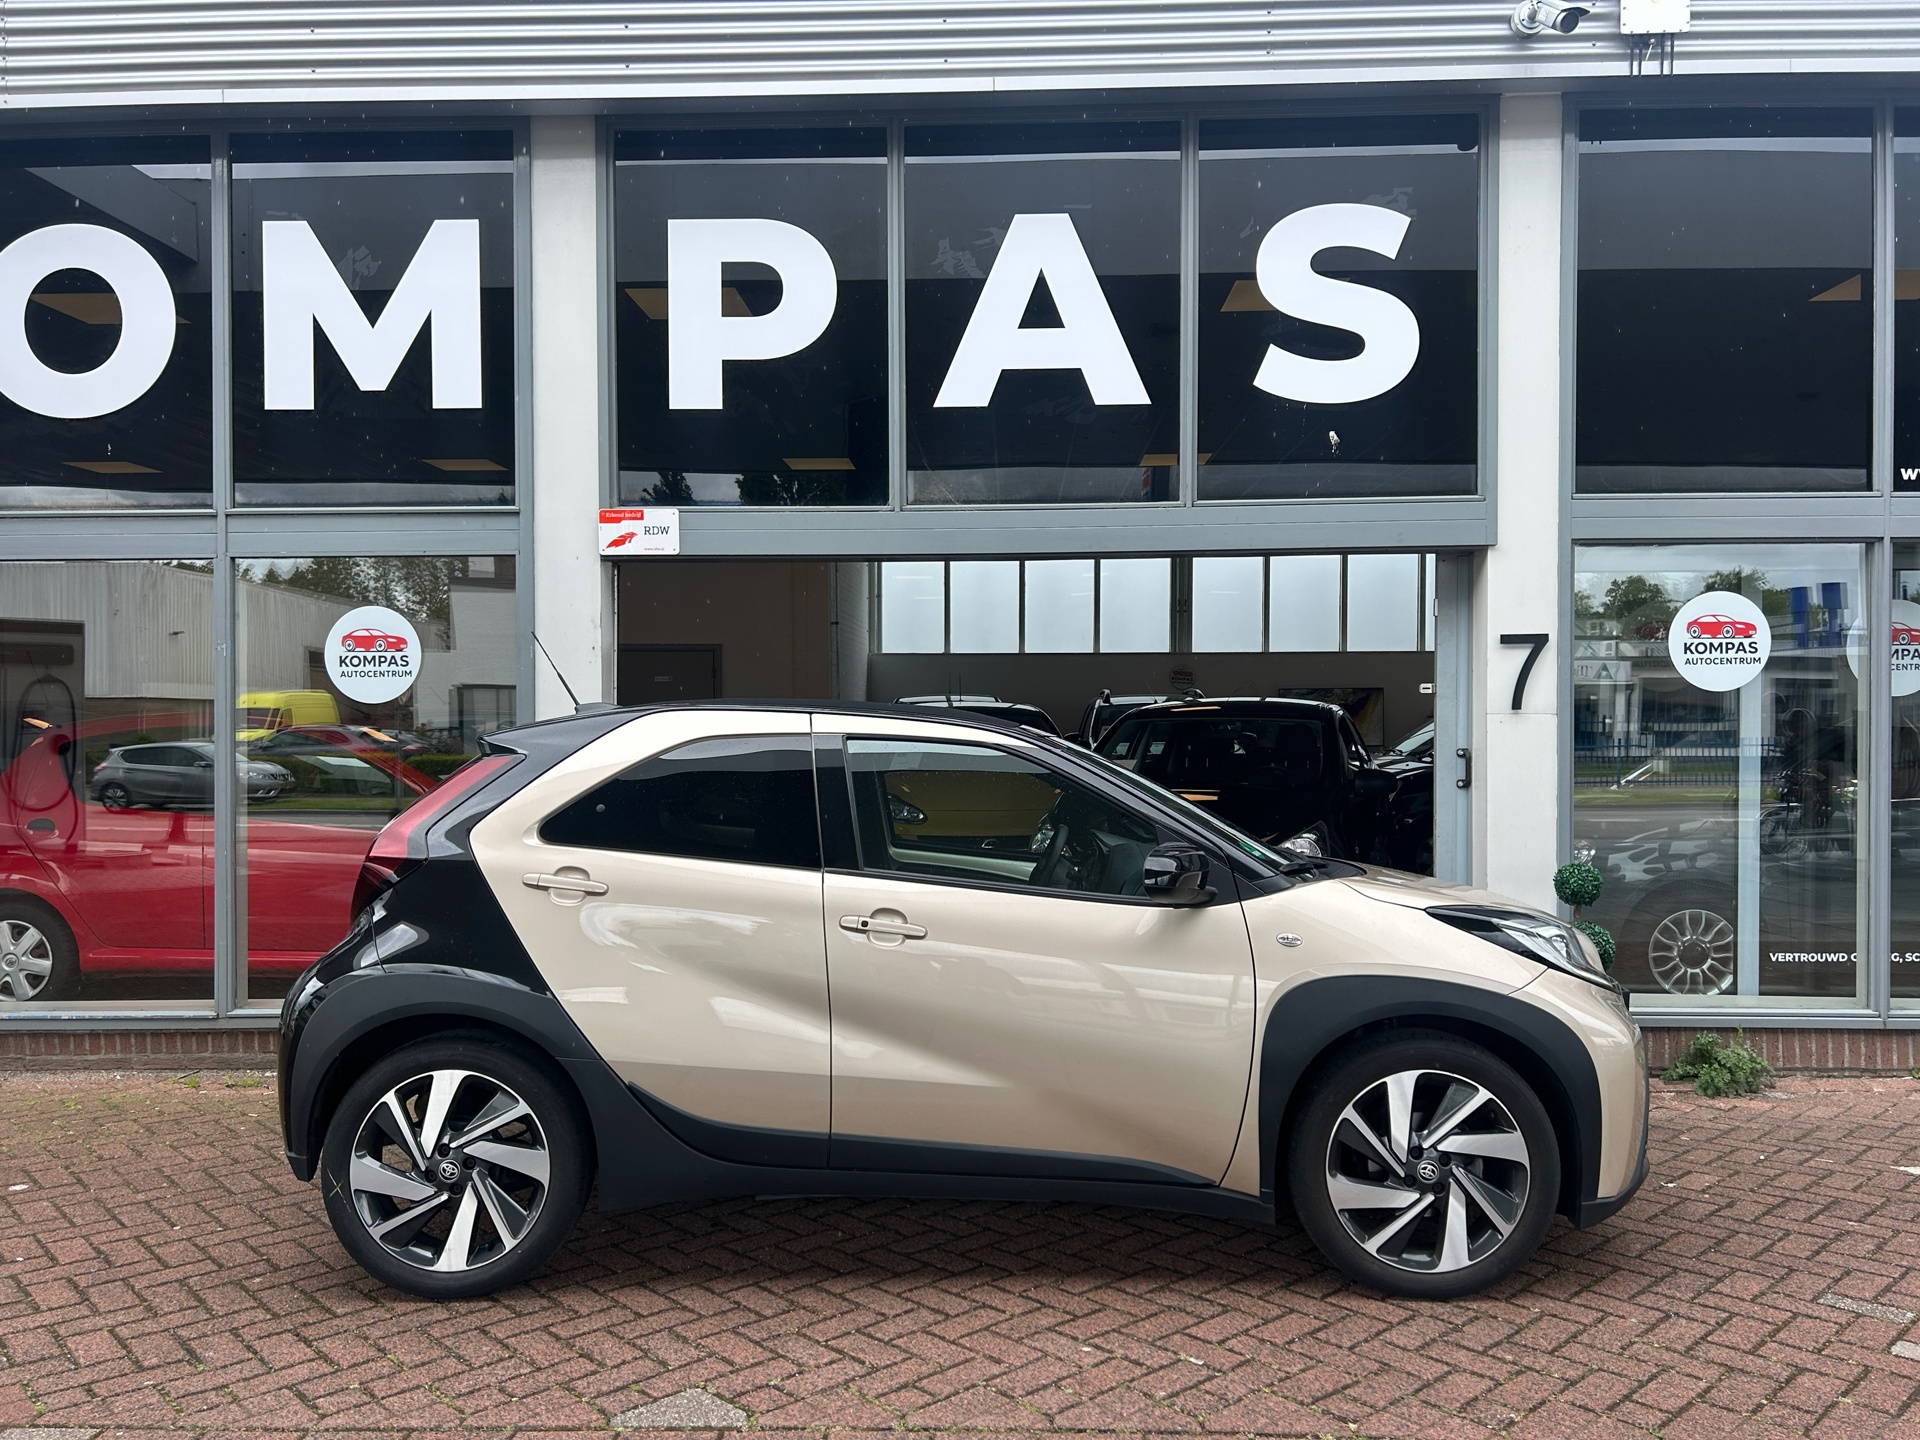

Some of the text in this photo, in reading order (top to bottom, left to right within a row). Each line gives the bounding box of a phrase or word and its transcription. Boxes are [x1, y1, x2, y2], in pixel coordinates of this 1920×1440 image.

[1900, 468, 1920, 480] w
[644, 526, 670, 535] RDW
[1683, 641, 1759, 655] KOMPAS
[339, 655, 409, 667] KOMPAS
[1684, 657, 1762, 665] AUTOCENTRUM
[340, 670, 413, 678] AUTOCENTRUM
[1500, 633, 1549, 710] 7
[1769, 952, 1848, 962] VERTROUWD
